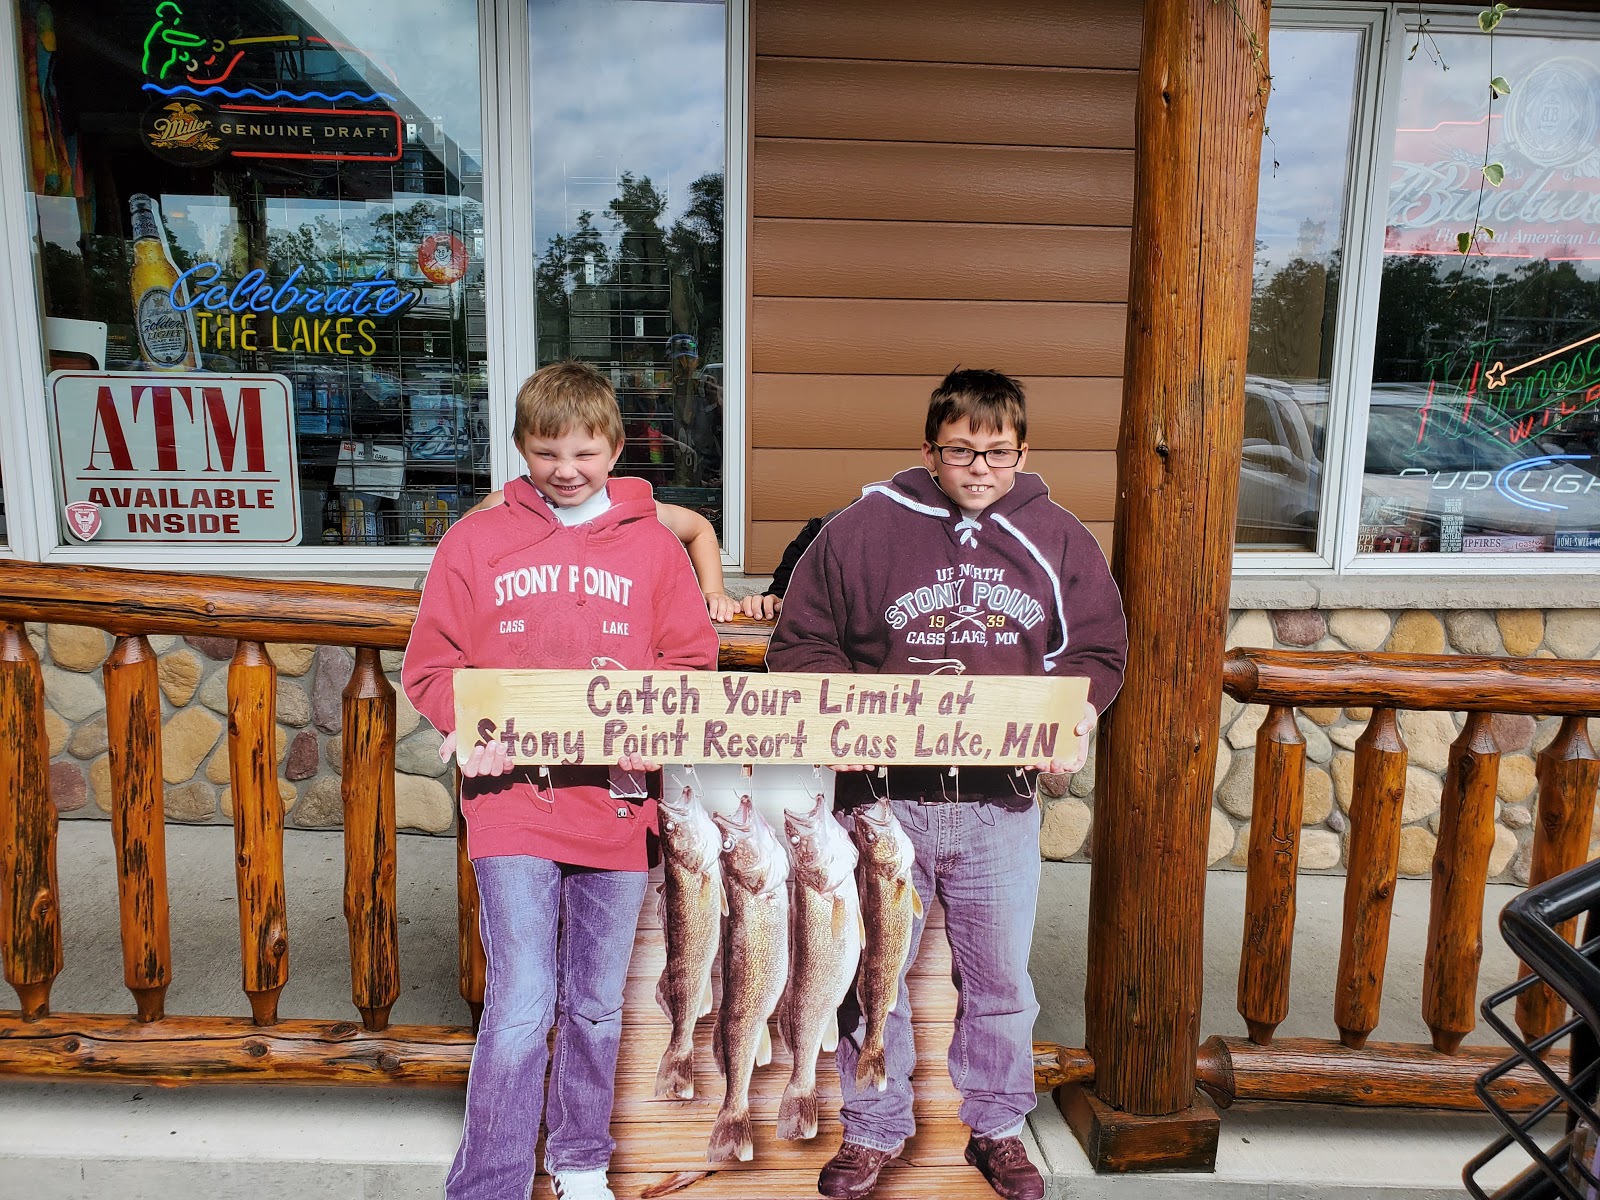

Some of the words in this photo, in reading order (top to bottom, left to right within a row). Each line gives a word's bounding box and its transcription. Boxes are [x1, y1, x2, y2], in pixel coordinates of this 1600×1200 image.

[153, 118, 213, 140] Miller
[220, 123, 312, 137] GENUINE
[324, 126, 389, 138] DRAFT
[1510, 229, 1583, 244] American
[169, 261, 416, 314] Celebrate
[197, 312, 258, 351] THE
[272, 316, 377, 356] LAKES
[82, 385, 272, 472] ATM
[88, 487, 275, 509] AVAILABLE
[127, 513, 240, 534] INSIDE
[1441, 525, 1463, 534] FAMILY
[1556, 537, 1572, 547] HOME
[1574, 537, 1593, 547] SWEET
[494, 565, 562, 606] STONY
[885, 579, 966, 630] STONY
[973, 581, 1046, 630] POINT
[500, 620, 525, 634] CASS
[602, 620, 630, 635] LAKE
[928, 615, 945, 628] 19
[986, 615, 1005, 628] 39
[906, 631, 946, 645] CASS
[995, 632, 1020, 645] MN
[586, 674, 700, 718] Catch
[722, 675, 802, 716] Your
[819, 678, 923, 716] Limit
[938, 680, 975, 716] at
[475, 717, 586, 765] Stony
[602, 718, 690, 757] Point
[702, 718, 808, 758] Resort
[830, 719, 898, 758] Cass
[914, 720, 992, 760] Lake,
[999, 721, 1060, 758] MN
